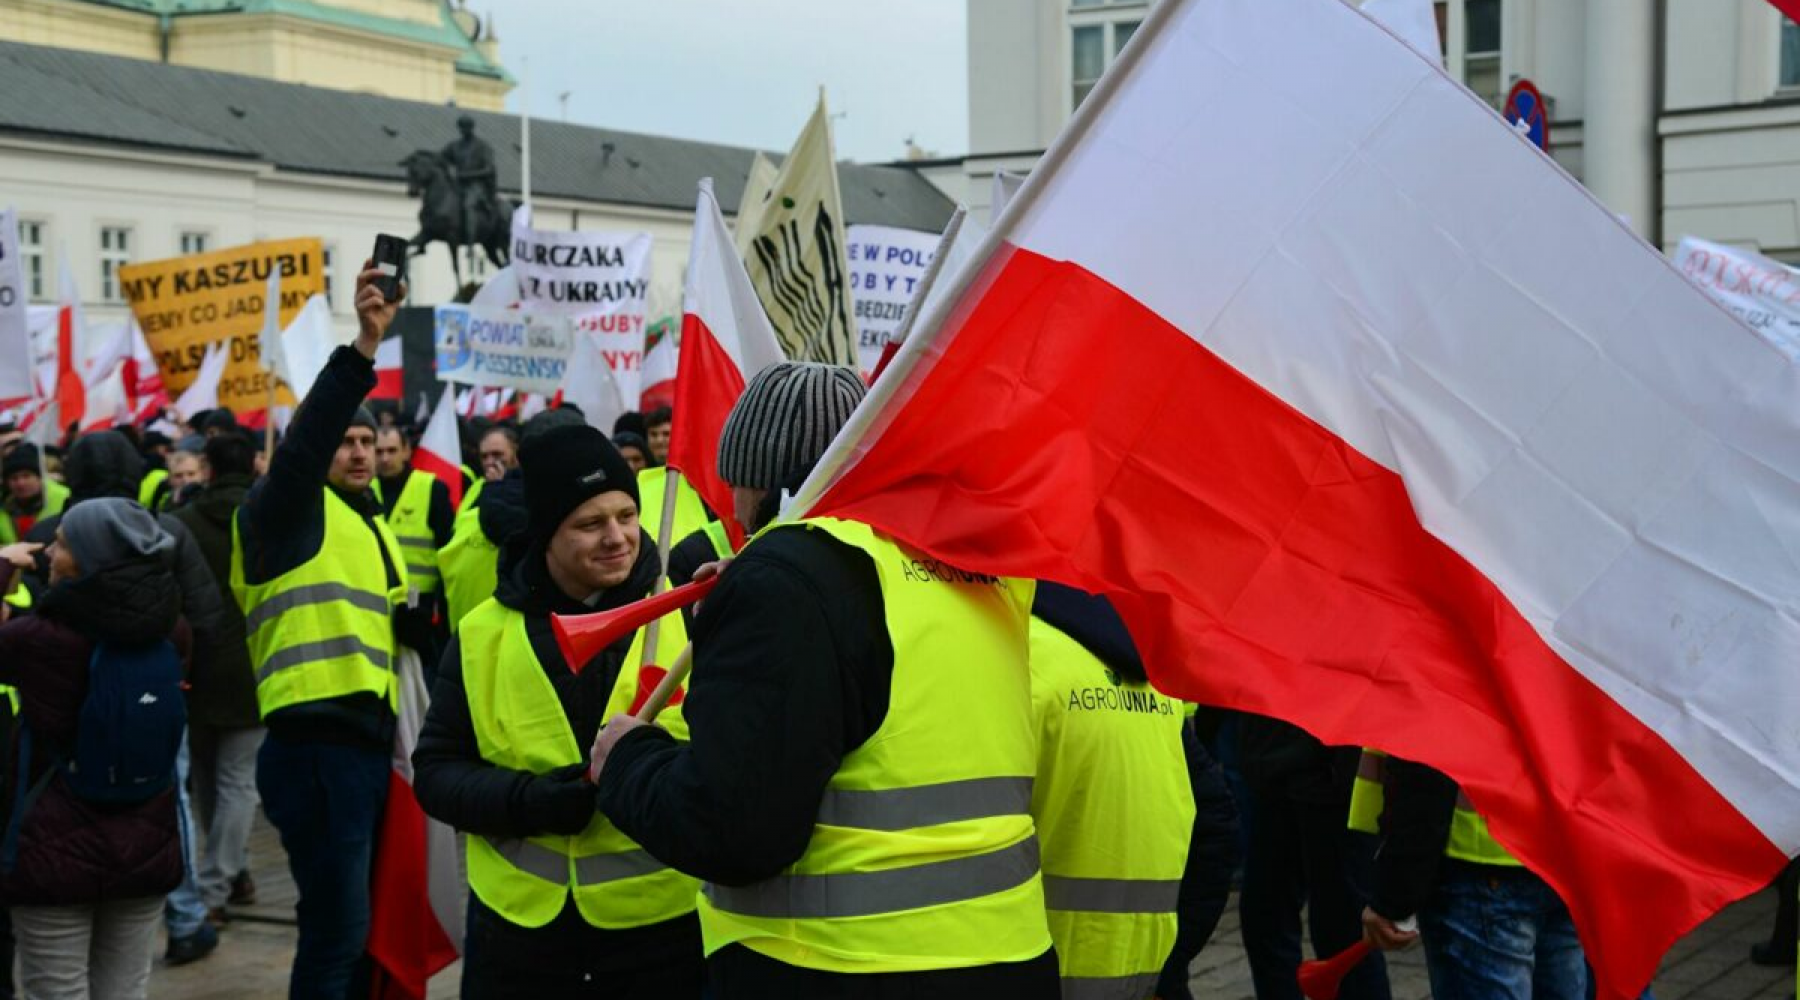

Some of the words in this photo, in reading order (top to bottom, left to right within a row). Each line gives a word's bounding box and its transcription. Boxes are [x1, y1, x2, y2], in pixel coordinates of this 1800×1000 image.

[886, 246, 934, 268] POL
[121, 275, 163, 301] MY
[173, 252, 310, 295] KASZUBI
[189, 304, 217, 324] CO
